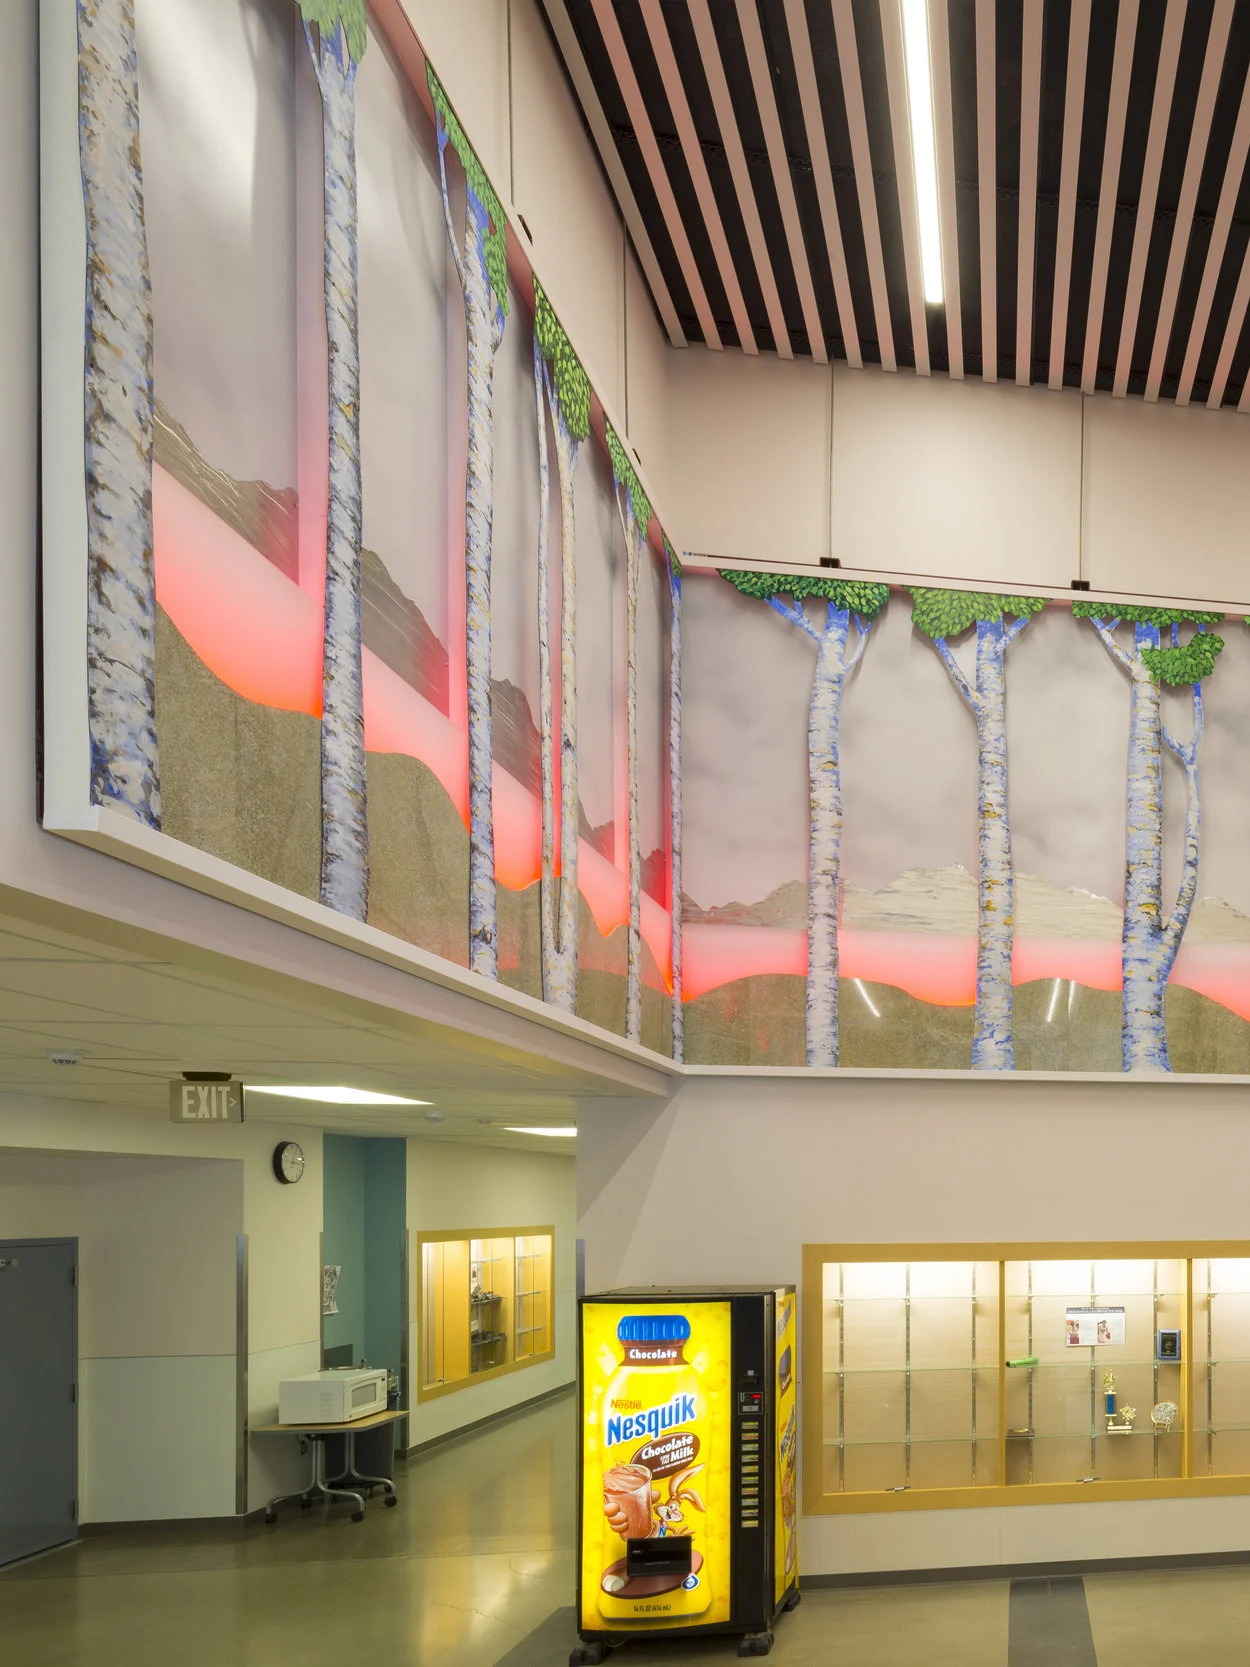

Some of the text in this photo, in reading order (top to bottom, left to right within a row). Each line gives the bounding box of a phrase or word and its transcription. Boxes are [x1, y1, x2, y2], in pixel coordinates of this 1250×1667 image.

[182, 1086, 230, 1118] EXIT
[629, 1348, 678, 1360] Chocolate
[607, 1394, 696, 1446] Nesquik
[641, 1435, 694, 1460] Chocolate
[670, 1445, 694, 1462] Milk
